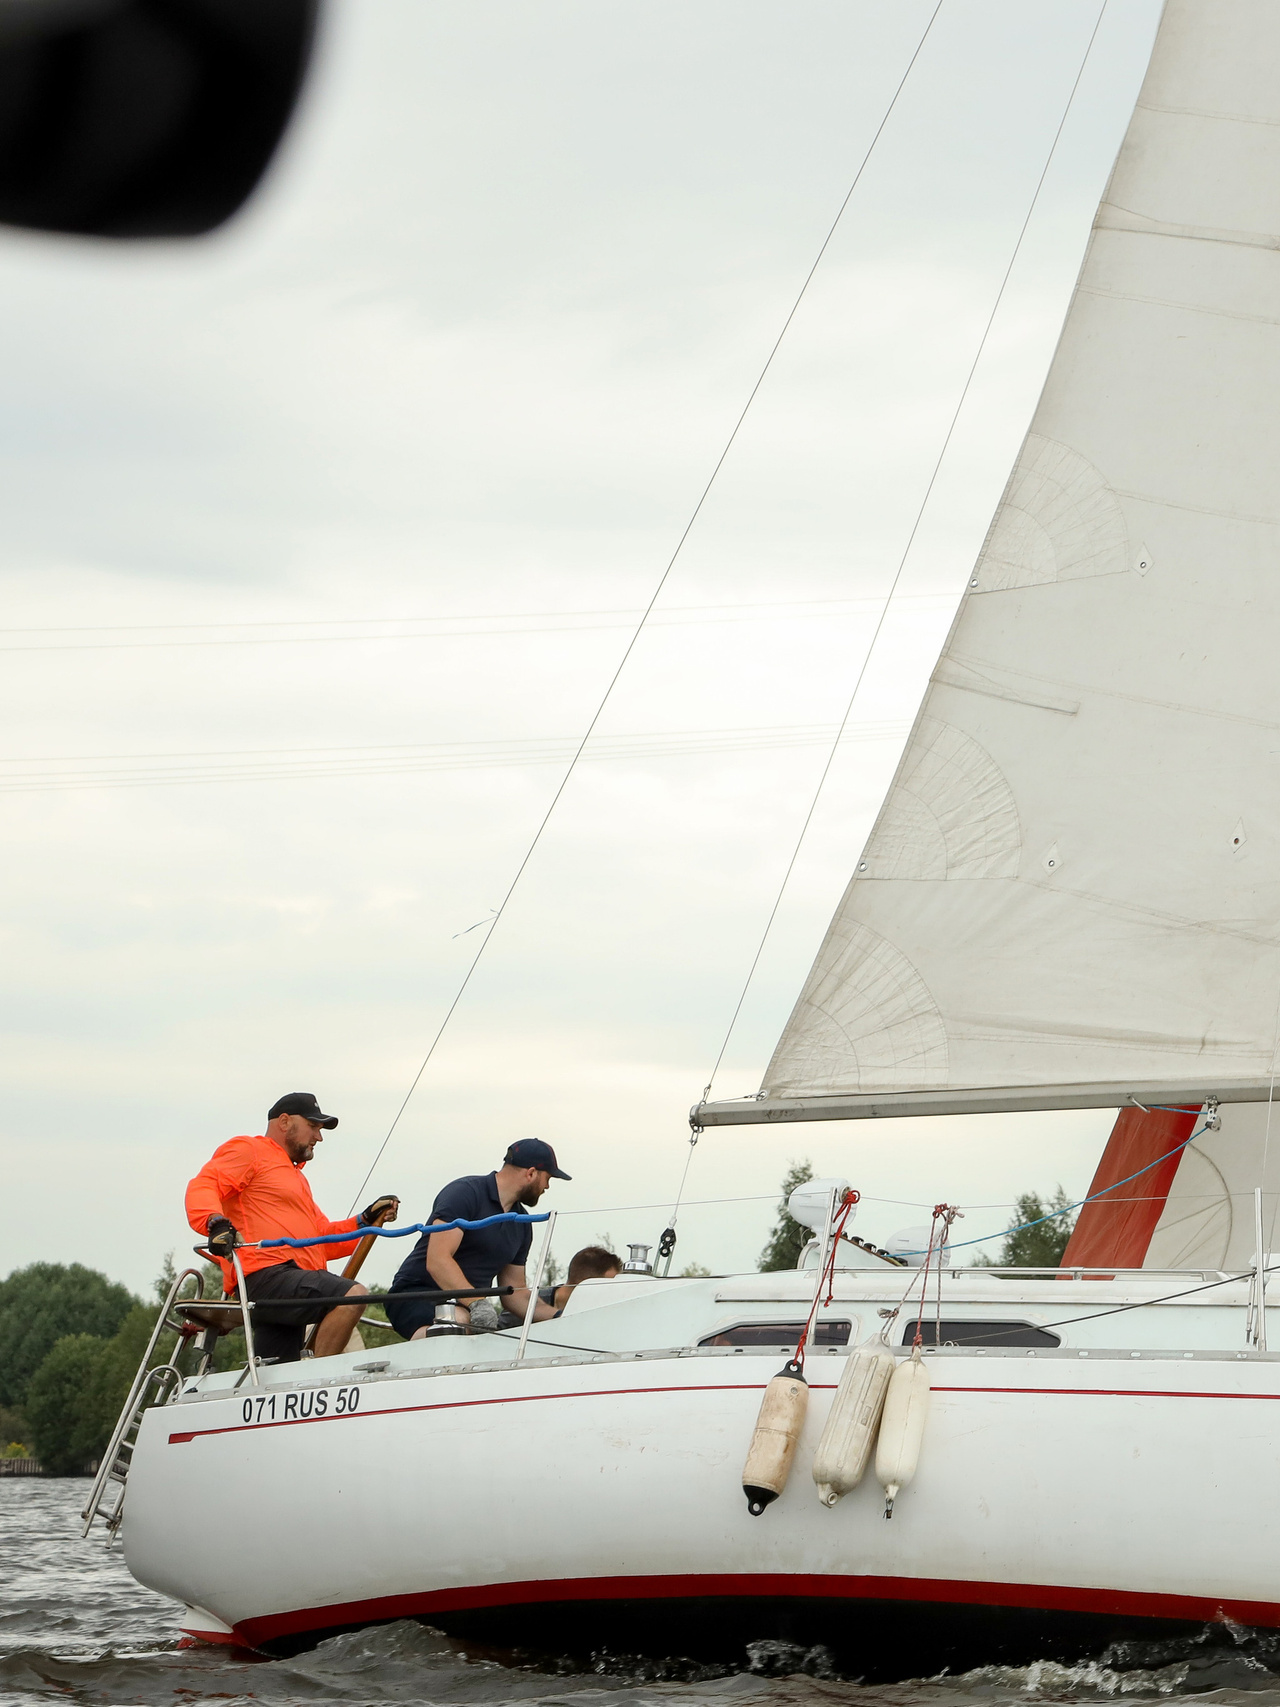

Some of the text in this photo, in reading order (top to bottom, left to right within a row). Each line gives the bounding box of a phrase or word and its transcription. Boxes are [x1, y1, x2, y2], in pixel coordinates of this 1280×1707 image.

[242, 1386, 360, 1423] 071 RUS 50
